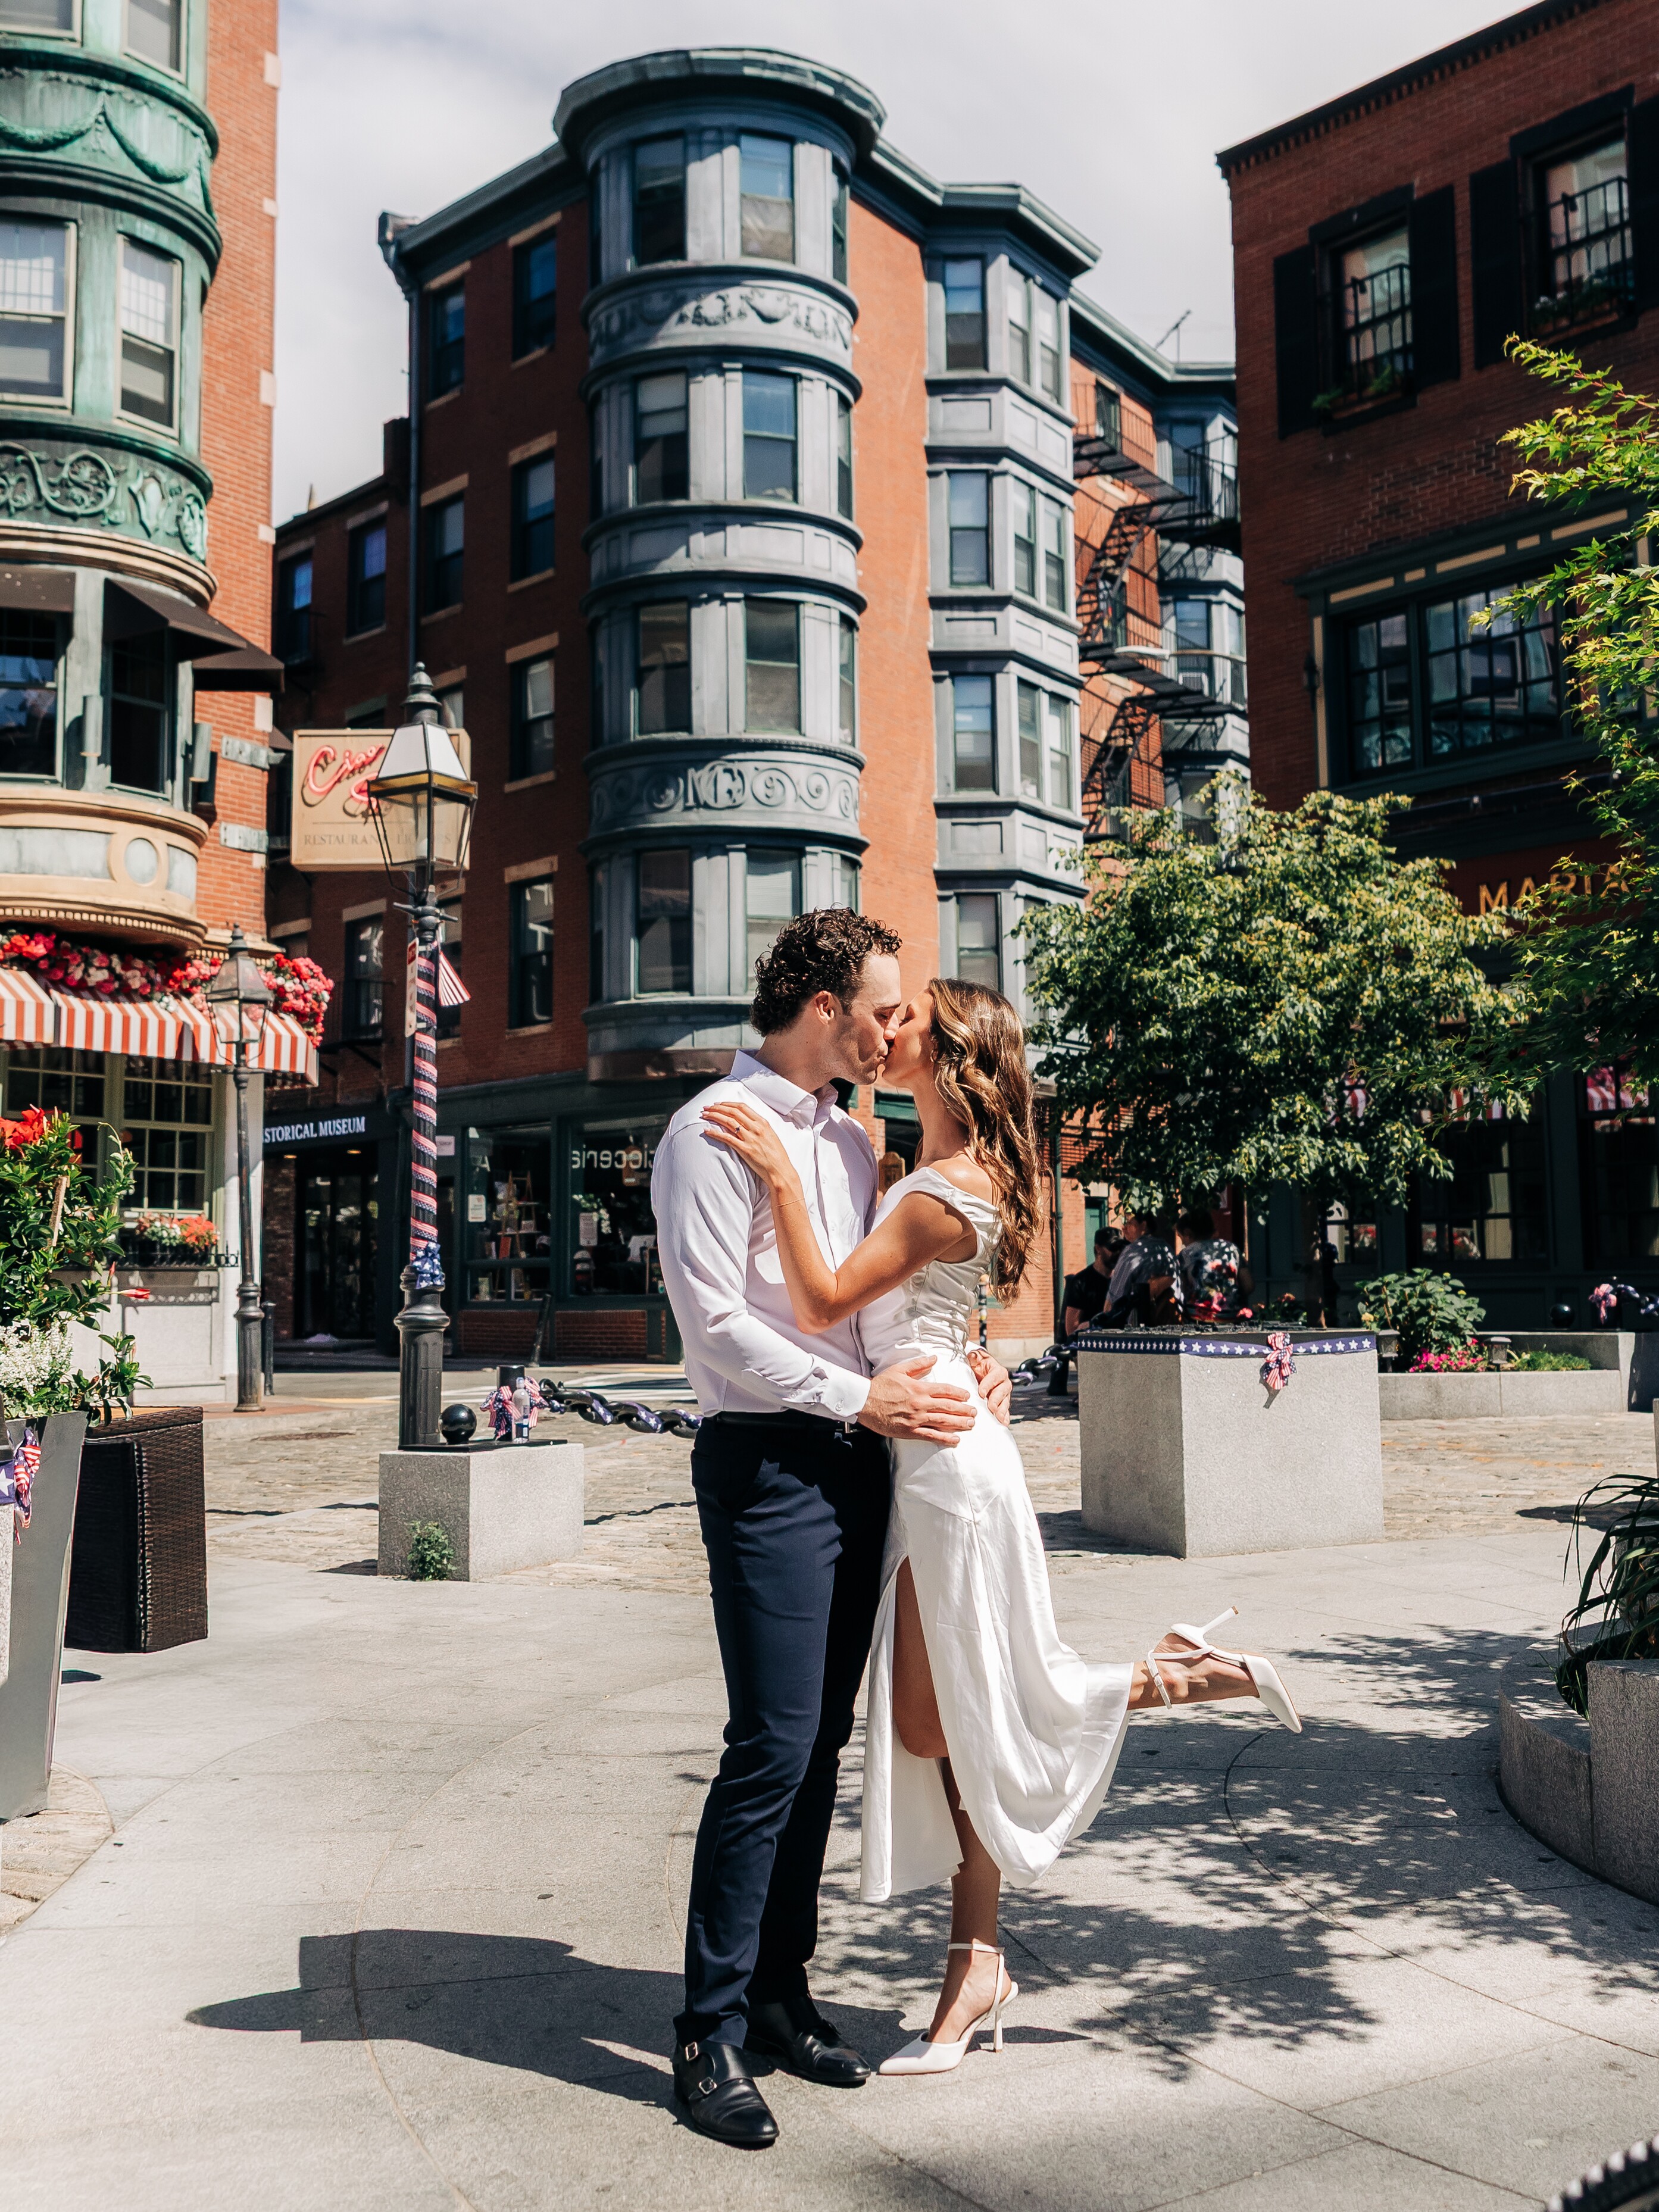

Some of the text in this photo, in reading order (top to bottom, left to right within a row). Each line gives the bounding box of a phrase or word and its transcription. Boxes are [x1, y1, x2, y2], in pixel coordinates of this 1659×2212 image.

[304, 834, 387, 846] RESTAURAN
[1479, 864, 1630, 916] MARIA
[318, 1116, 365, 1137] MUSEUM
